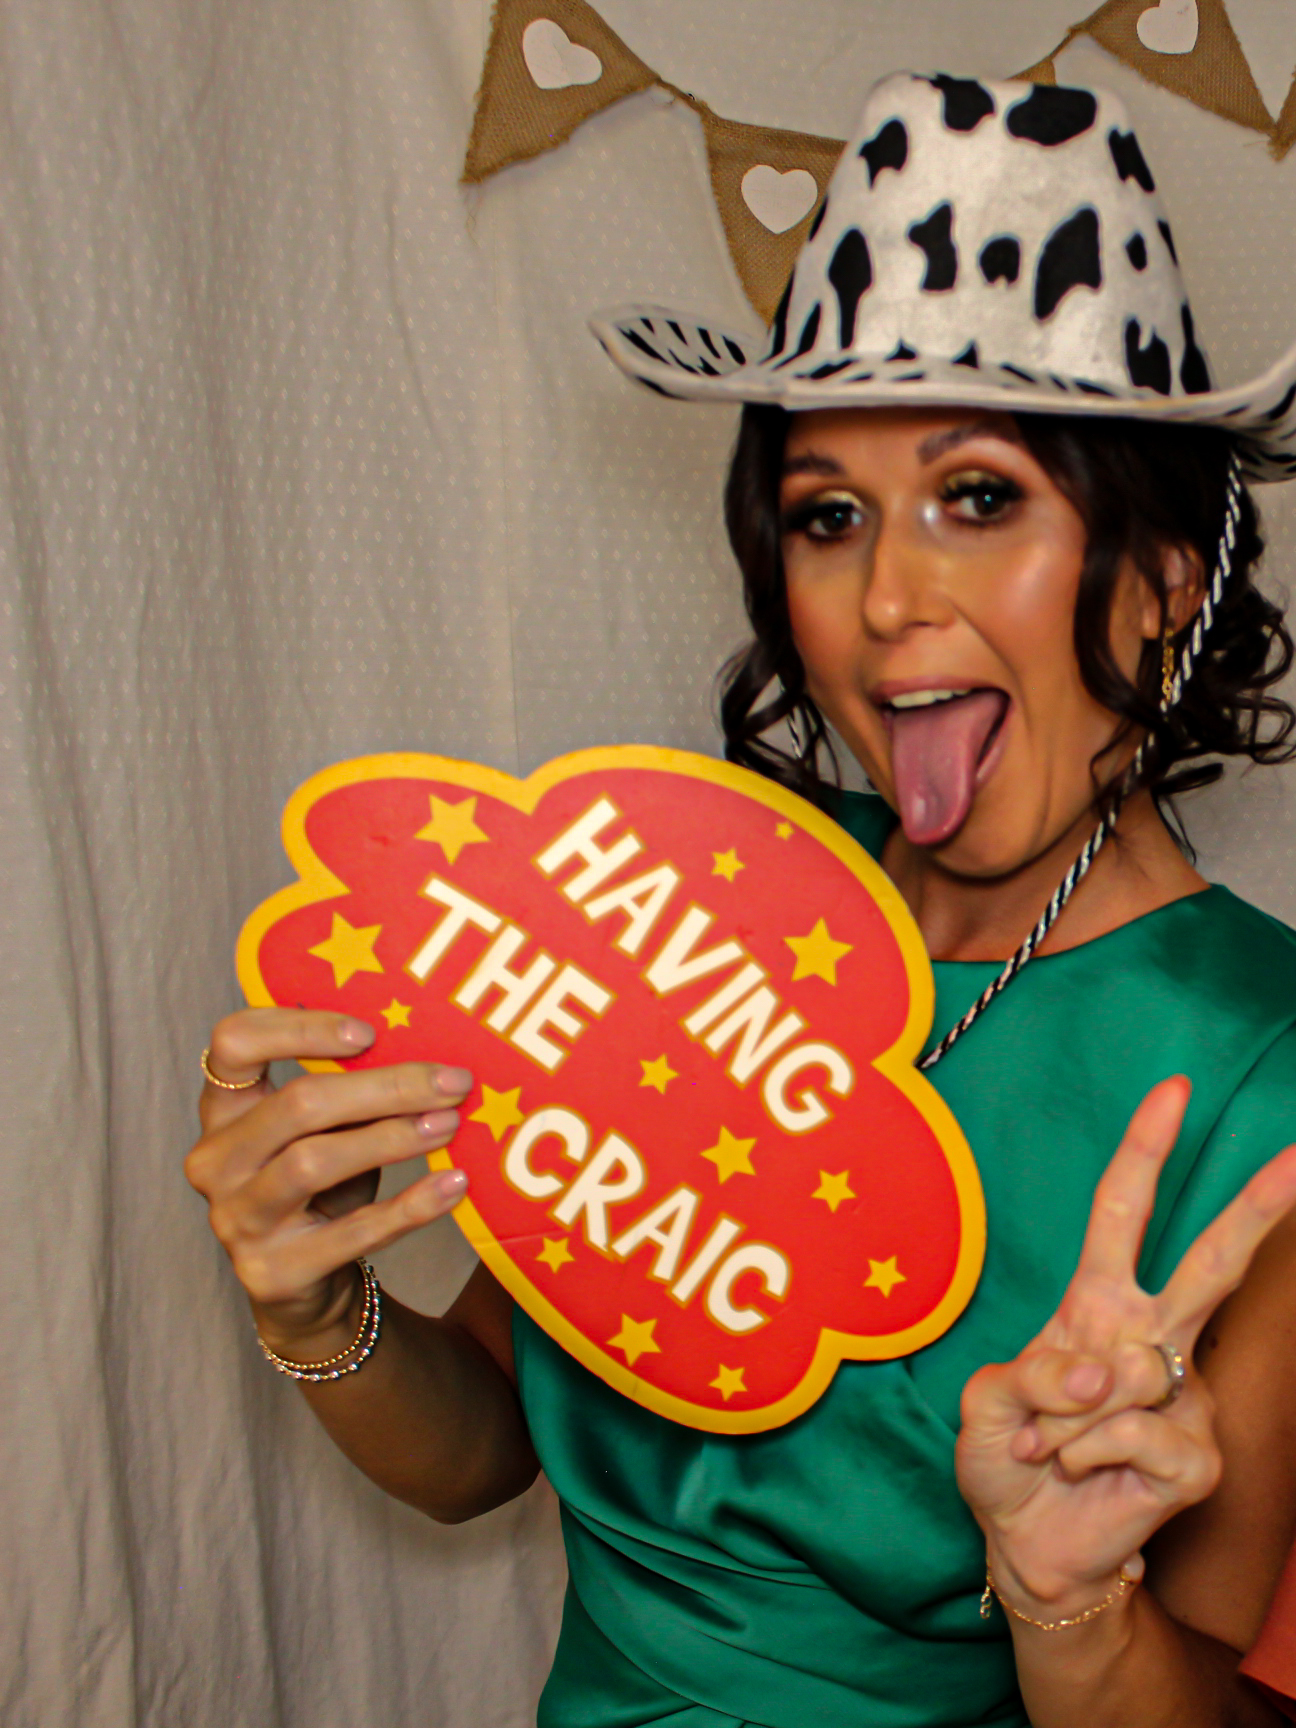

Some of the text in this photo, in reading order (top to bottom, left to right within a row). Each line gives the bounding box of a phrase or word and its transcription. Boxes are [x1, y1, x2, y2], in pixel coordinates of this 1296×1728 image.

[405, 875, 614, 1072] THE
[534, 796, 854, 1134] HAVING
[503, 1107, 789, 1333] CRAIC
